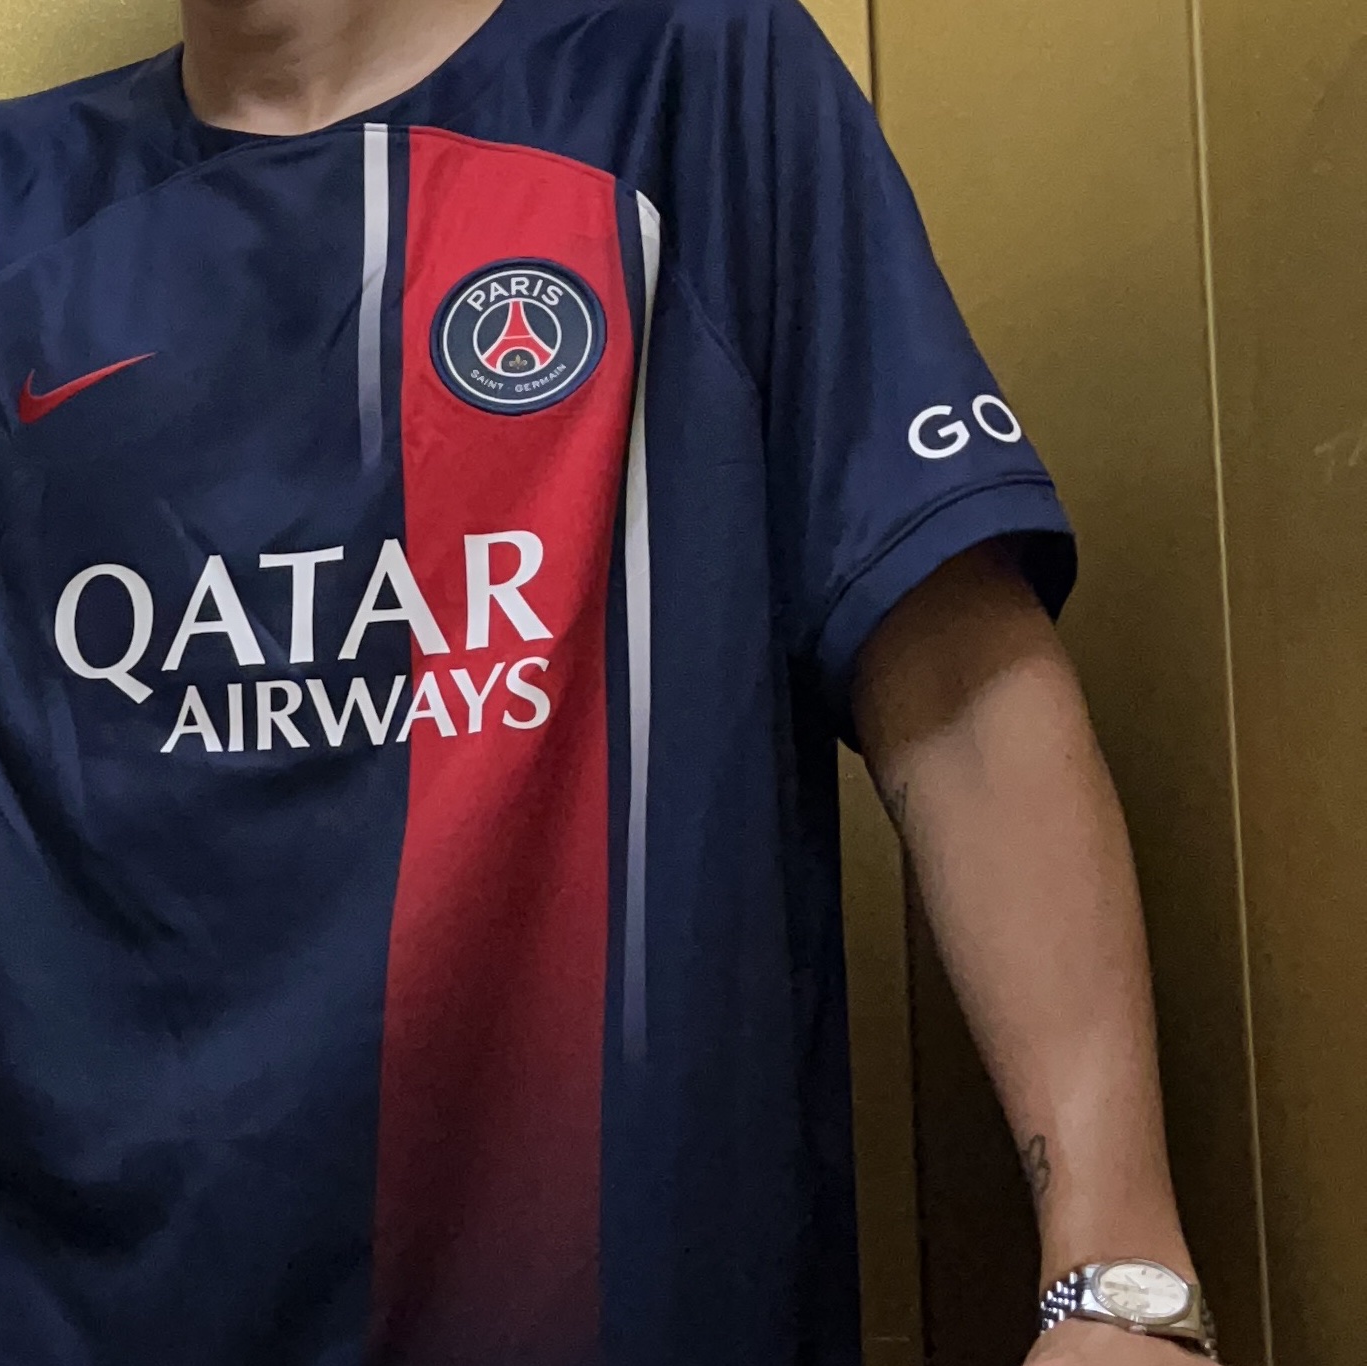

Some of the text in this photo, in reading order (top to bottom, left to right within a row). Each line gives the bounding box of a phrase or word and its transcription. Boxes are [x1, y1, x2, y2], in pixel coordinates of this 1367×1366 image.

[467, 277, 564, 312] PARIS
[470, 363, 567, 393] SAINT GERMAIN
[908, 394, 1022, 459] GO
[54, 530, 554, 704] QATAR
[160, 656, 552, 753] AIRWAYS
